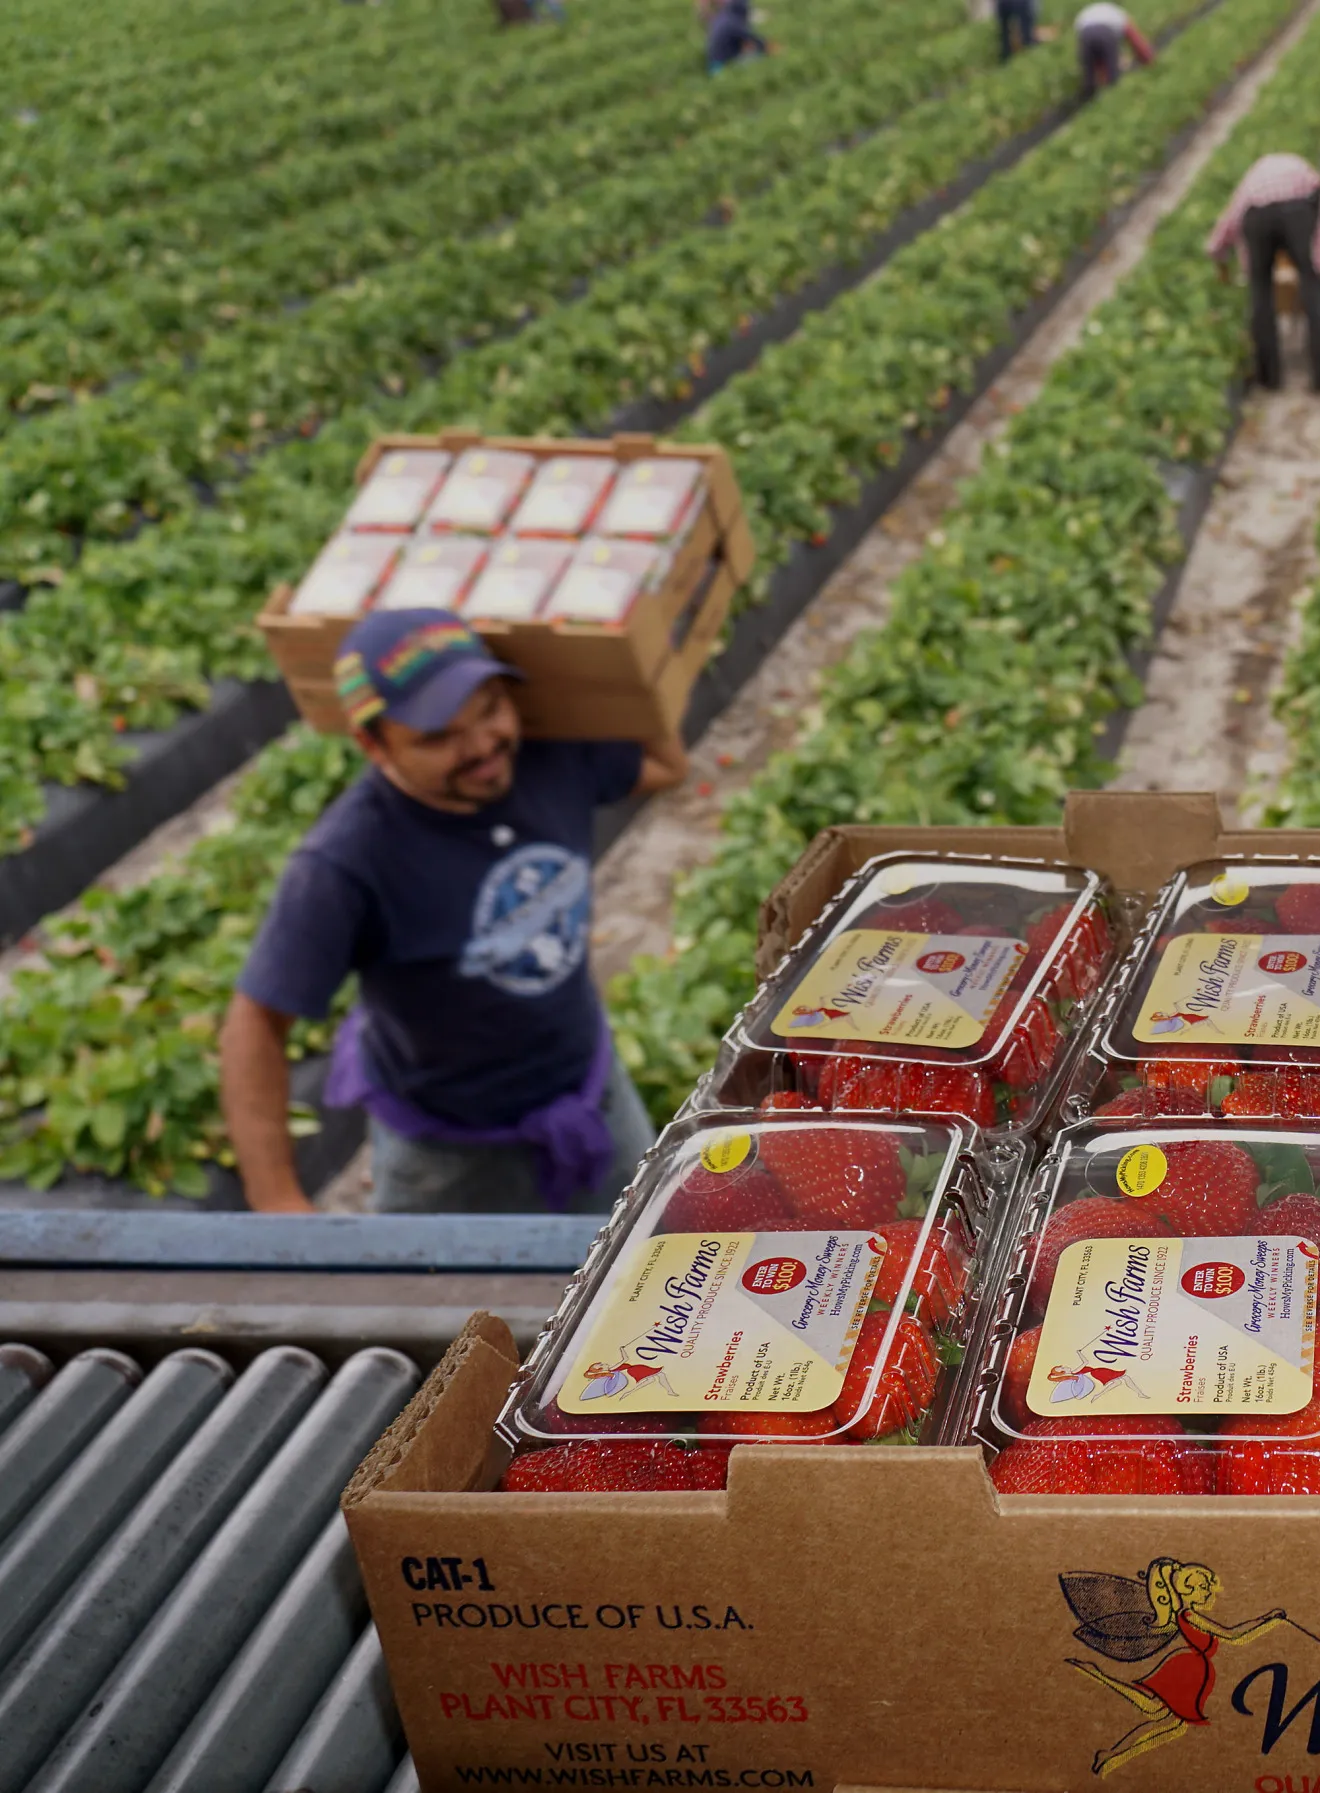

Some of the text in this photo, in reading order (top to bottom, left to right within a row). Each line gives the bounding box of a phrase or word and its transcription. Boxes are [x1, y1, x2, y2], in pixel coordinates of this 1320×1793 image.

[857, 935, 902, 972] Farms
[1185, 938, 1237, 1011] Wish Farms
[1243, 995, 1265, 1036] Strawberries
[1270, 1019, 1282, 1037] Product
[1082, 1245, 1092, 1262] 33563
[629, 1282, 643, 1301] PLANT
[639, 1267, 653, 1280] CITY,
[752, 1265, 768, 1286] ENTER
[761, 1263, 779, 1288] TO WIN
[772, 1261, 797, 1289] $100!
[791, 1235, 840, 1329] Grocery Money Sweeps
[817, 1243, 848, 1315] WEEKLY WINNERS
[829, 1244, 862, 1315] HowsMyPicking.com
[1077, 1271, 1088, 1285] CITY,
[1105, 1244, 1149, 1303] Farms
[1193, 1270, 1204, 1290] ENTER
[1203, 1268, 1214, 1292] TO WIN
[1213, 1266, 1233, 1293] $100!
[1243, 1240, 1271, 1332] Grocery Money Sweeps
[1267, 1247, 1279, 1318] WEEKLY WINNERS
[1280, 1248, 1295, 1318] HowsMyPicking.com
[635, 1239, 720, 1360] Wish Farms
[680, 1241, 739, 1358] QUALITY PRODUCE SINCE 1922
[1072, 1286, 1083, 1305] PLANT
[1140, 1246, 1168, 1360] QUALITY PRODUCE SINCE 1922
[1093, 1306, 1139, 1363] Wish
[704, 1332, 742, 1400] Strawberries
[739, 1342, 769, 1400] Product of USA
[1176, 1335, 1198, 1402] Strawberries
[1213, 1345, 1227, 1402] Product of USA
[767, 1373, 785, 1400] Net Wt.
[401, 1556, 495, 1591] CAT-1
[412, 1603, 755, 1631] PRODUCE OF U.S.A.
[490, 1662, 728, 1691] WISH FARMS
[439, 1692, 810, 1725] PLANT CITY, FL 33563
[543, 1742, 710, 1764] VISIT US AT
[454, 1764, 815, 1789] WWW.WISHFARMS.COM
